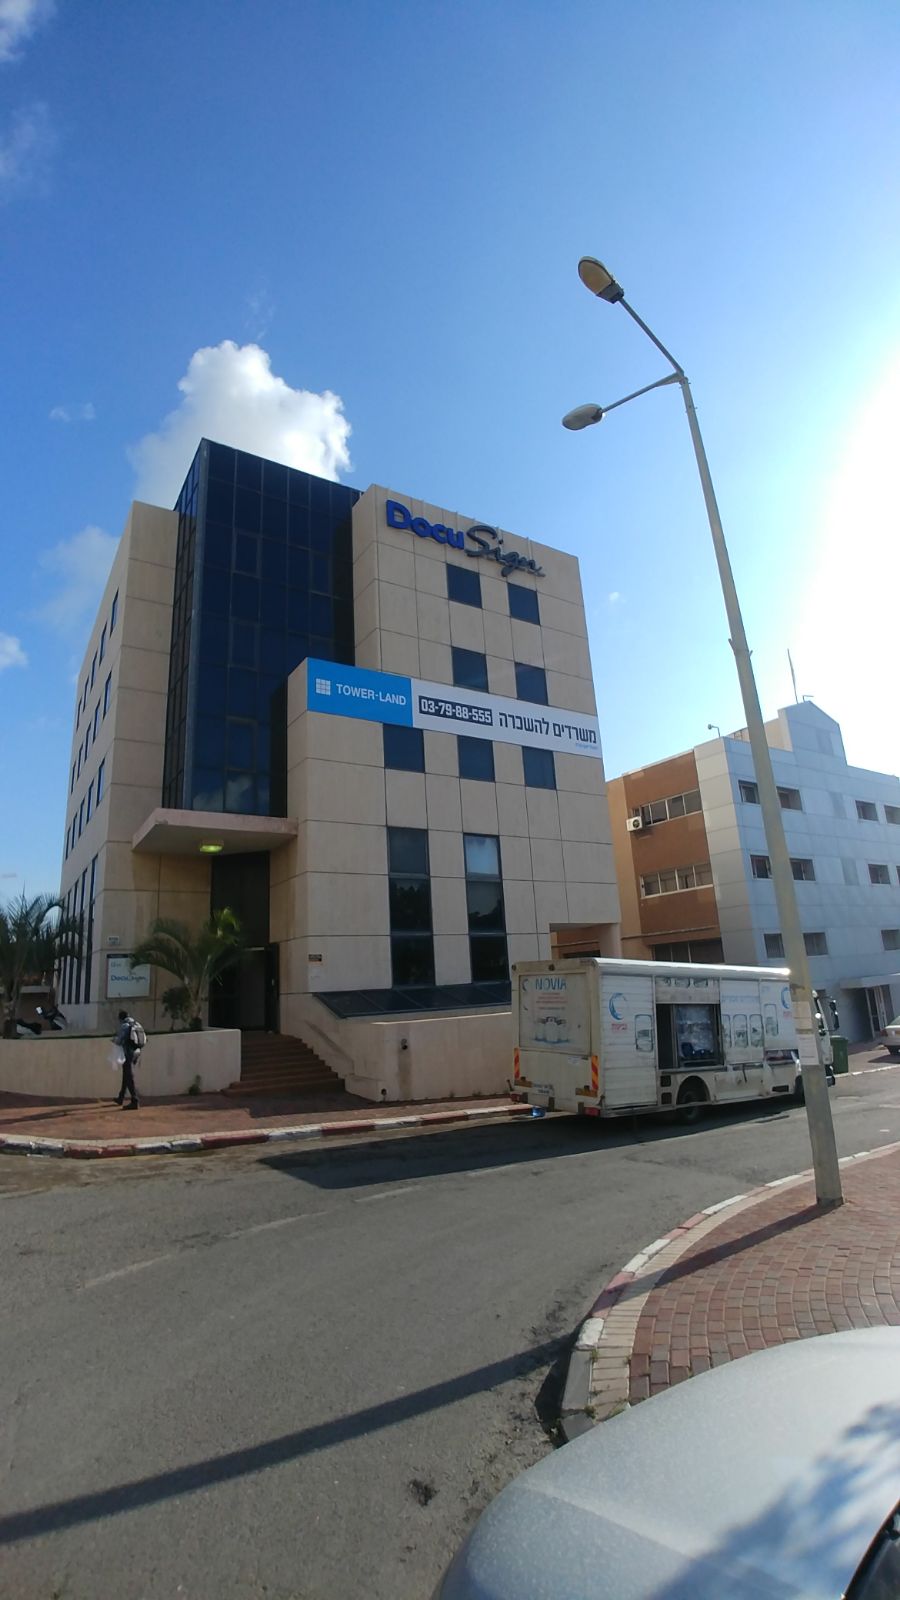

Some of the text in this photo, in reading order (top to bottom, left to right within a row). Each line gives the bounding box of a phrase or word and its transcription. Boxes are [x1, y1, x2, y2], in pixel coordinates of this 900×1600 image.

[386, 499, 546, 577] DocuSign
[335, 683, 407, 706] TOWER-LAND
[420, 698, 492, 724] 03-79-88-555
[498, 711, 597, 744] משרדים להשכרה
[535, 977, 567, 991] NOVIA
